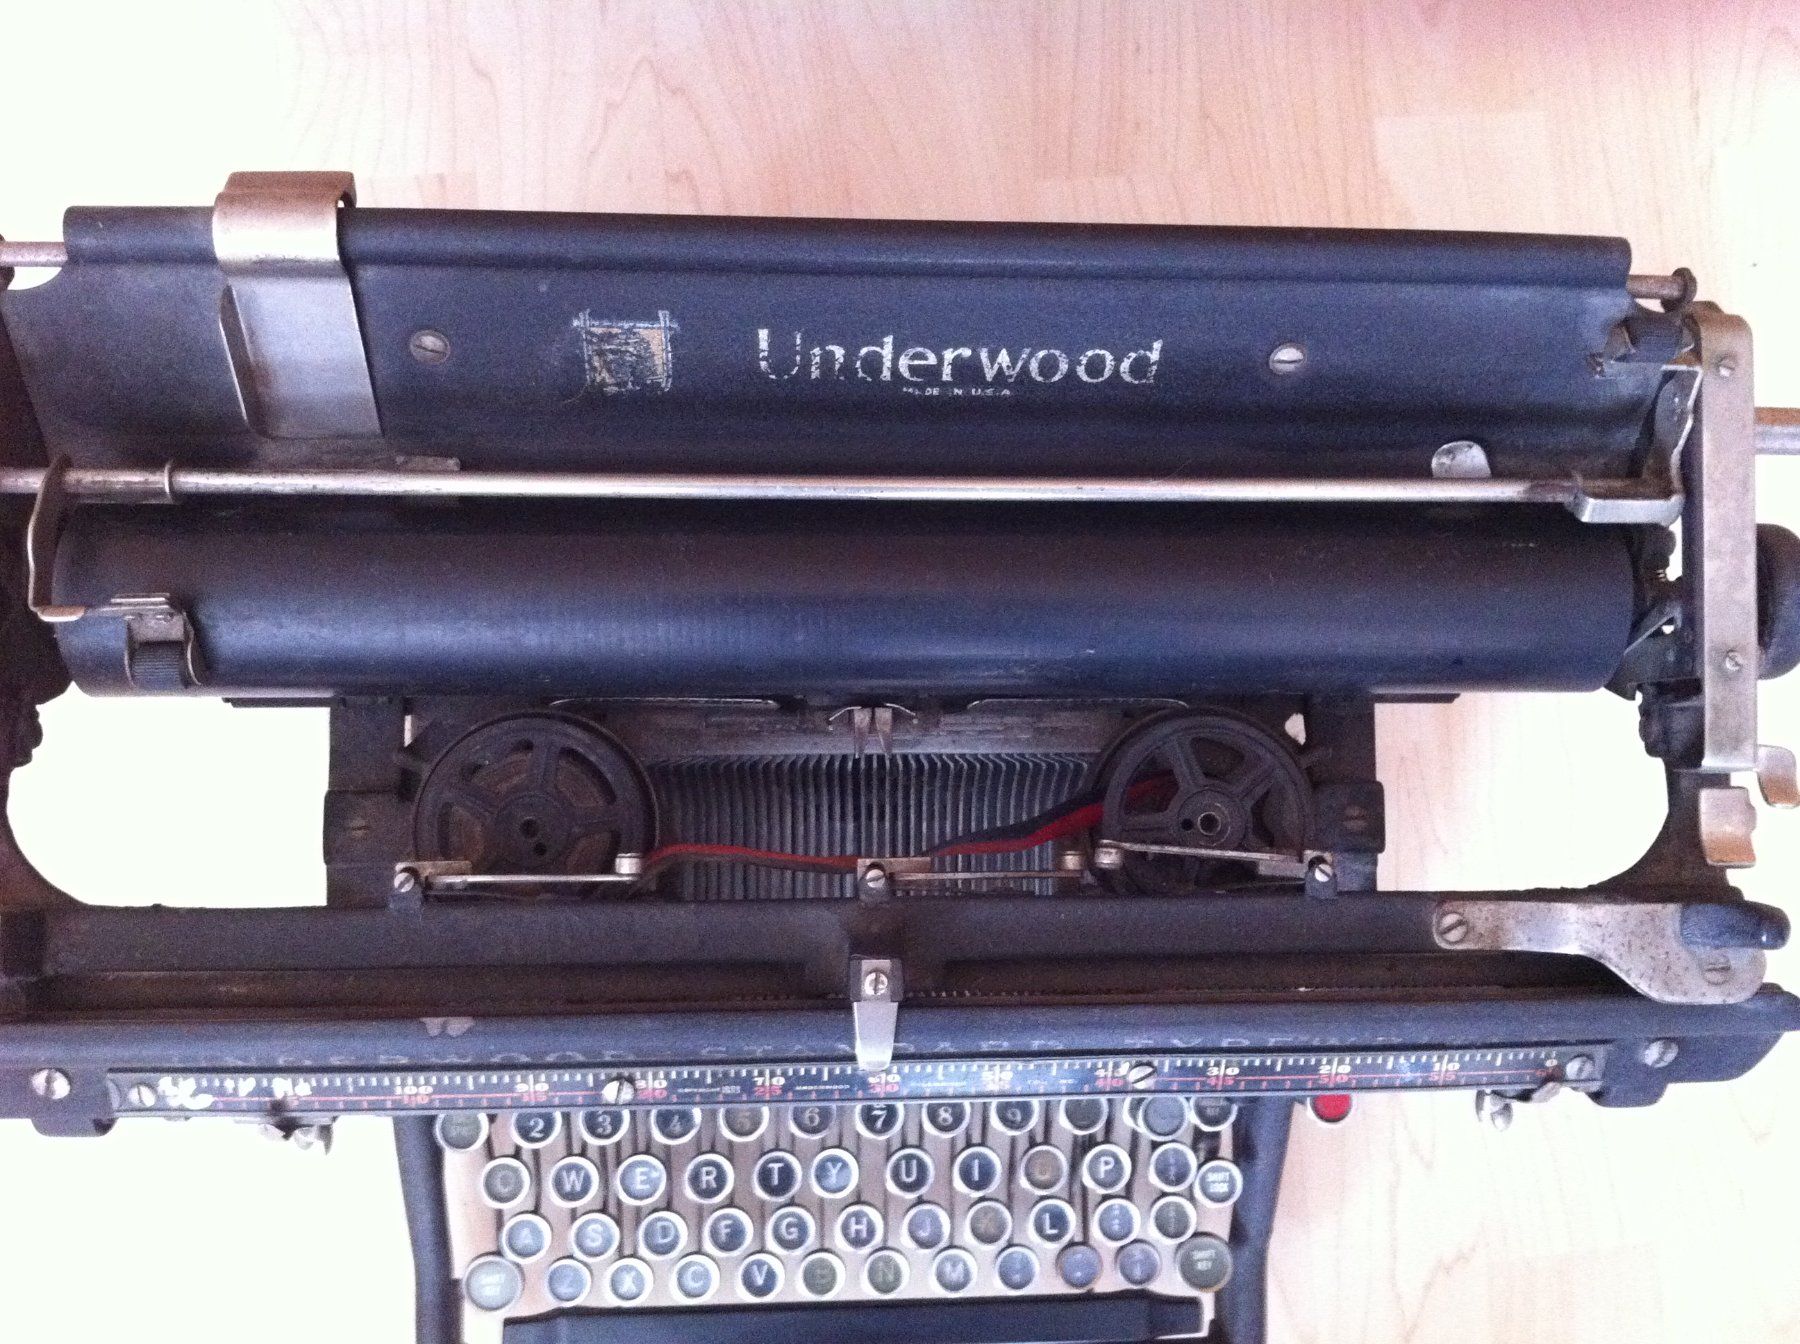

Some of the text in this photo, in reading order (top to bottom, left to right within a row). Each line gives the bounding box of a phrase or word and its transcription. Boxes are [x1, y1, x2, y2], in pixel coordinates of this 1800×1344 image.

[757, 327, 1164, 384] Underwood
[1206, 1066, 1241, 1076] 30
[1318, 1063, 1351, 1074] 20
[1432, 1061, 1461, 1072] 10
[529, 1117, 545, 1138] 2
[596, 1114, 612, 1135] 3
[803, 1107, 820, 1127] 6
[871, 1109, 888, 1130] 7
[936, 1106, 953, 1126] 8
[1006, 1107, 1022, 1126] 9
[634, 1167, 652, 1190] E
[701, 1166, 717, 1189] R
[766, 1162, 784, 1186] T
[826, 1161, 842, 1184] Y
[900, 1158, 917, 1182] U
[972, 1158, 980, 1181] I
[1099, 1156, 1115, 1179] P
[561, 1169, 584, 1192] W
[656, 1221, 676, 1244] D
[717, 1220, 733, 1243] F
[780, 1217, 799, 1241] G
[851, 1216, 868, 1239] H
[917, 1216, 932, 1238] J
[1043, 1212, 1059, 1234] L
[587, 1223, 604, 1248] S
[618, 1270, 637, 1293] X
[687, 1265, 706, 1289] C
[751, 1263, 769, 1287] V
